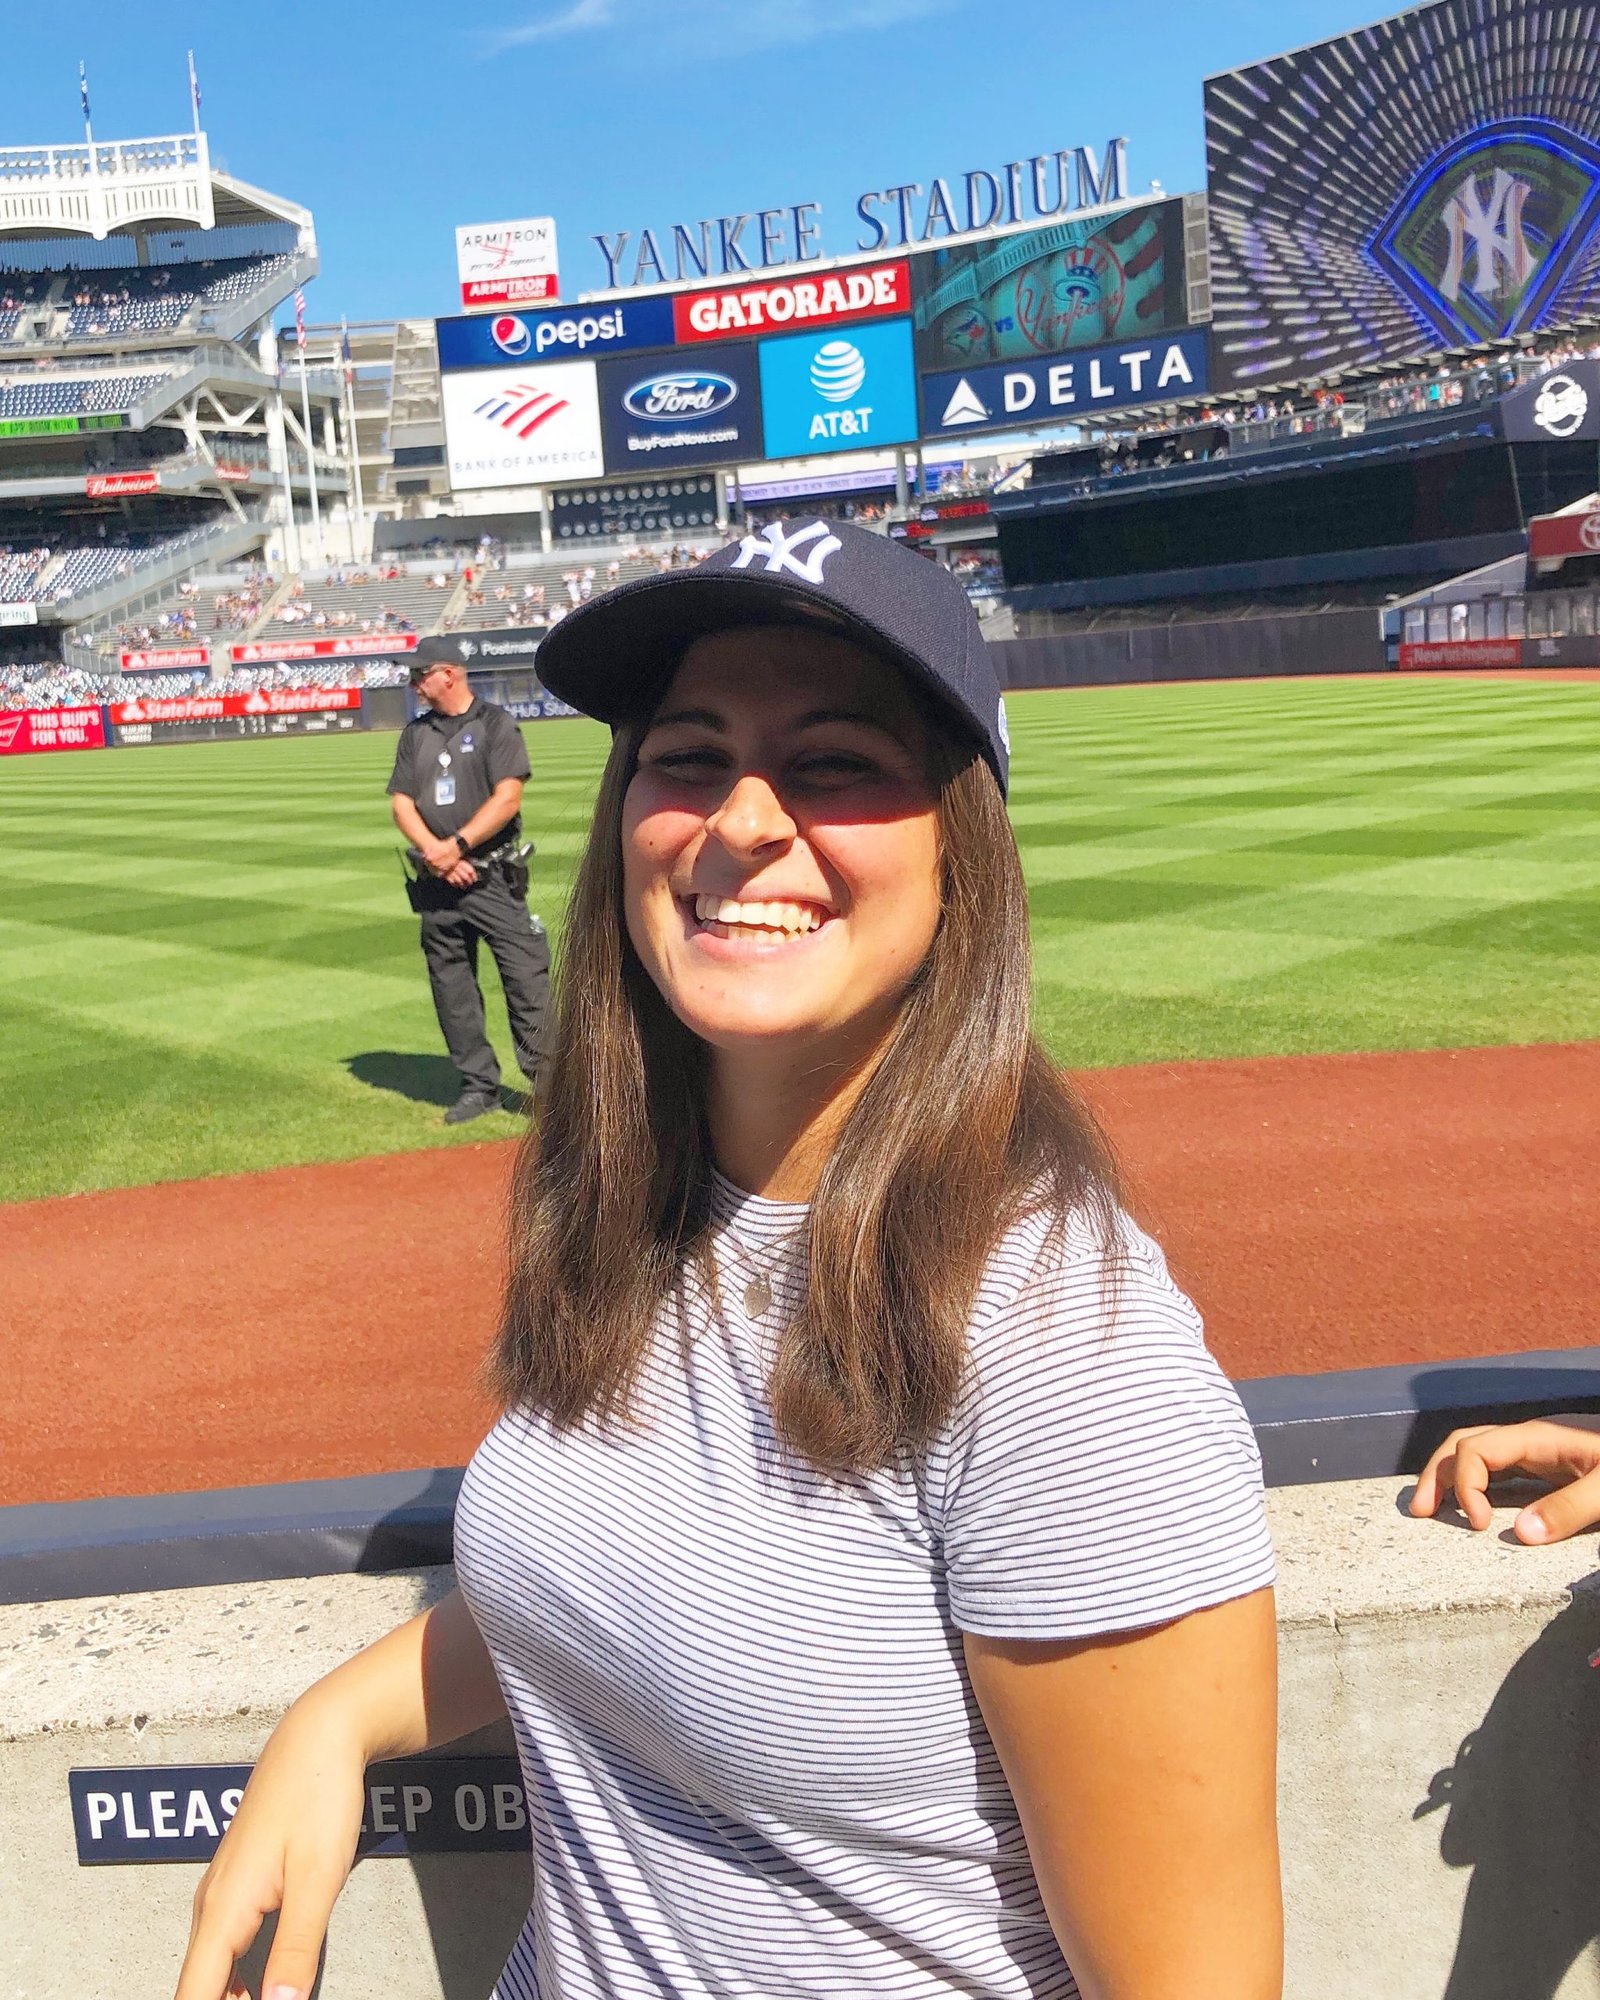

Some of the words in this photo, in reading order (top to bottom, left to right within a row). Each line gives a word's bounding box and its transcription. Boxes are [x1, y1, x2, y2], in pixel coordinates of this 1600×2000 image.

[590, 202, 822, 289] YANKEE
[856, 136, 1130, 252] STADIUM
[462, 228, 548, 248] ARMITRON
[469, 277, 548, 297] ARMITRON
[689, 269, 898, 333] GATORADE
[536, 309, 625, 353] pepsi
[1004, 345, 1193, 413] DELTA
[645, 379, 715, 414] Ford
[809, 408, 873, 439] AT&T
[454, 460, 497, 473] BANK
[502, 457, 521, 468] OF
[527, 450, 598, 465] AMERICA
[91, 476, 157, 495] Budweiser
[481, 640, 541, 656] Postmate
[28, 711, 59, 729] THIS
[60, 710, 100, 727] BUD'S
[31, 730, 57, 746] FOR
[58, 728, 89, 744] YOU.
[455, 1783, 526, 1833] OB
